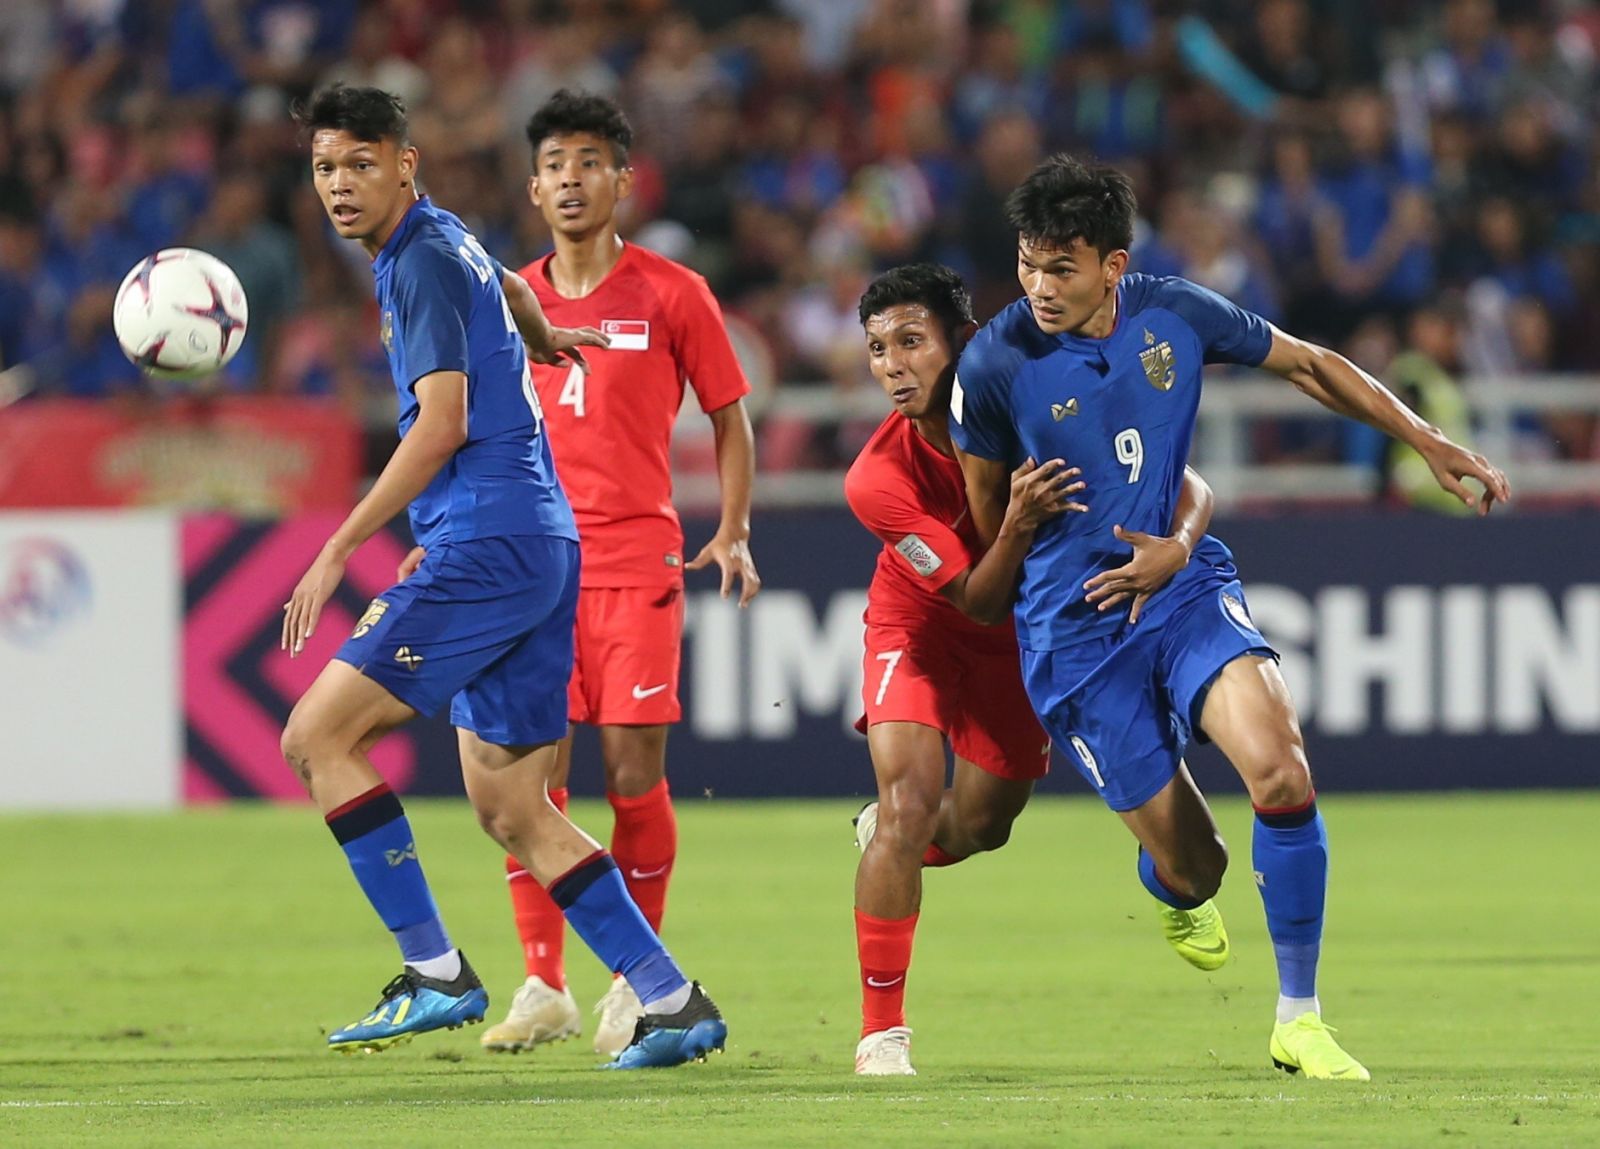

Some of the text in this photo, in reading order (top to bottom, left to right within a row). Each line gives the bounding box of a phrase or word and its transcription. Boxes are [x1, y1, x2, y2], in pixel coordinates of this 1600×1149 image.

[557, 361, 586, 417] 4
[1114, 427, 1144, 484] 9
[876, 649, 903, 706] 7
[1070, 735, 1106, 788] 9
